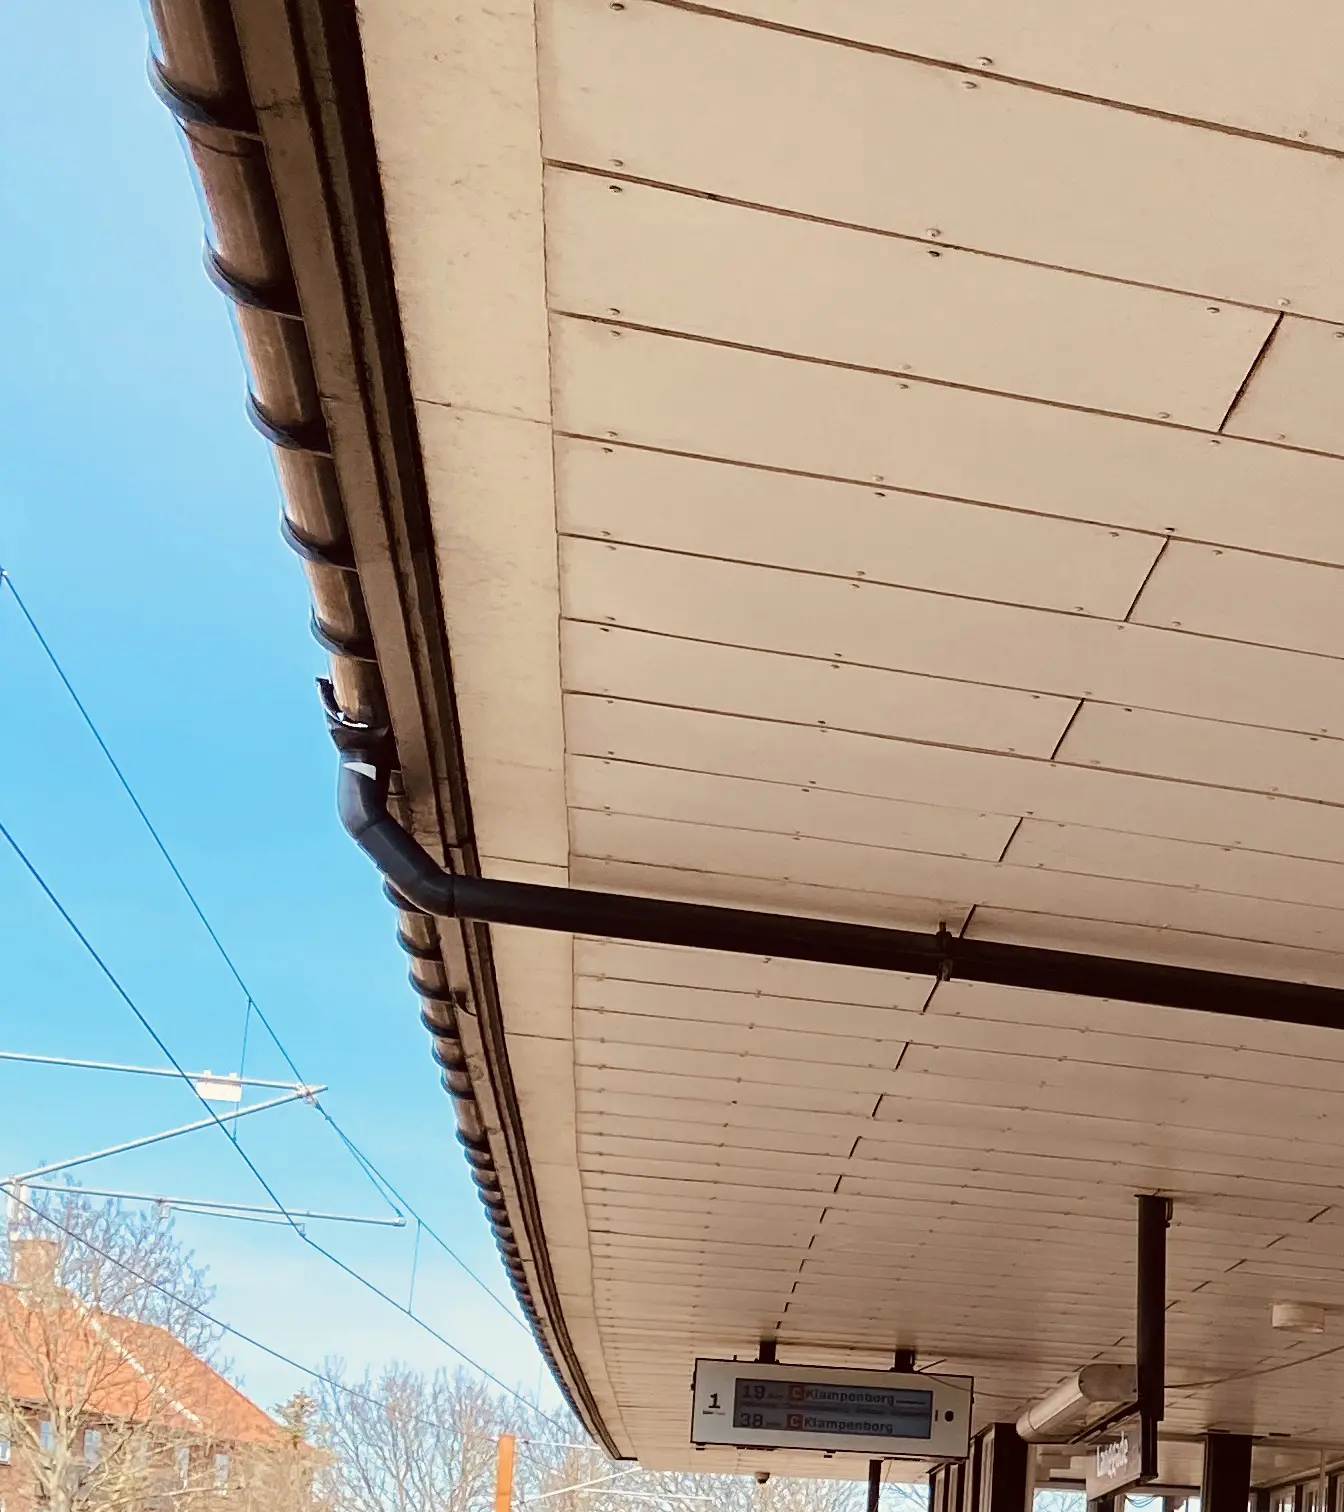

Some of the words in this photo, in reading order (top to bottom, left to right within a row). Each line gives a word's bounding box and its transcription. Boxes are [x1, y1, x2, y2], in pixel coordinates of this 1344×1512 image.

[708, 1393, 721, 1409] 1
[805, 1387, 896, 1407] Klampenborg
[804, 1416, 894, 1434] Klampenborg
